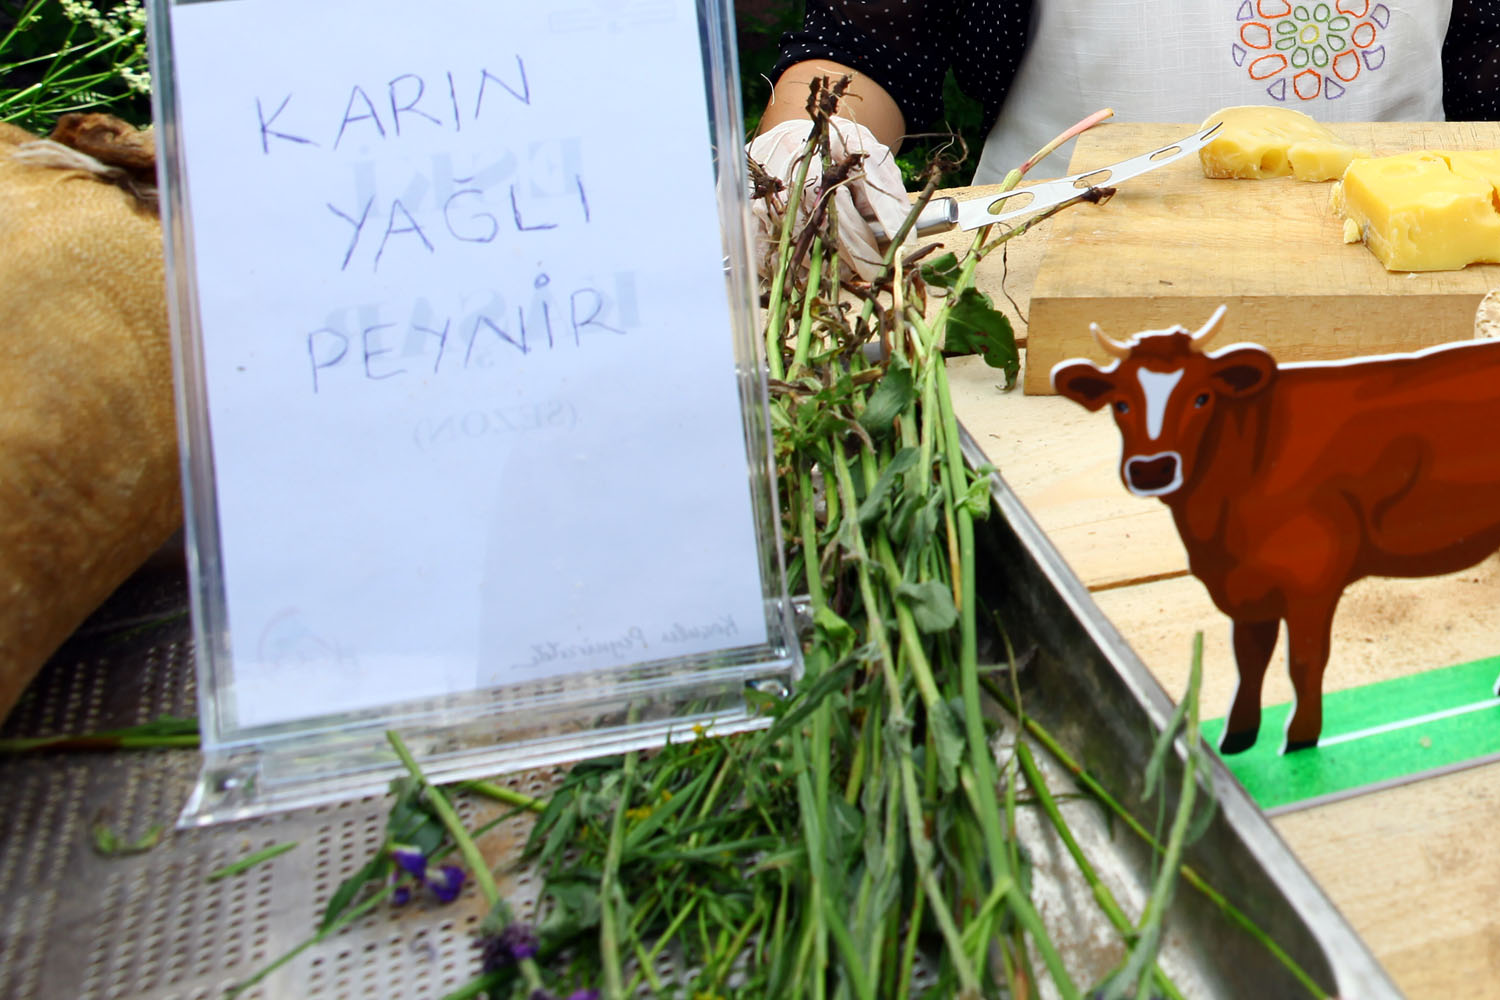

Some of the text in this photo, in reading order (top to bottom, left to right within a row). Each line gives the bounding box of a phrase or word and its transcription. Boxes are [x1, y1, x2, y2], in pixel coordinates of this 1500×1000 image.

[256, 54, 531, 155] KARIN
[326, 173, 590, 273] YAĞLI
[306, 272, 627, 394] PEYNİR
